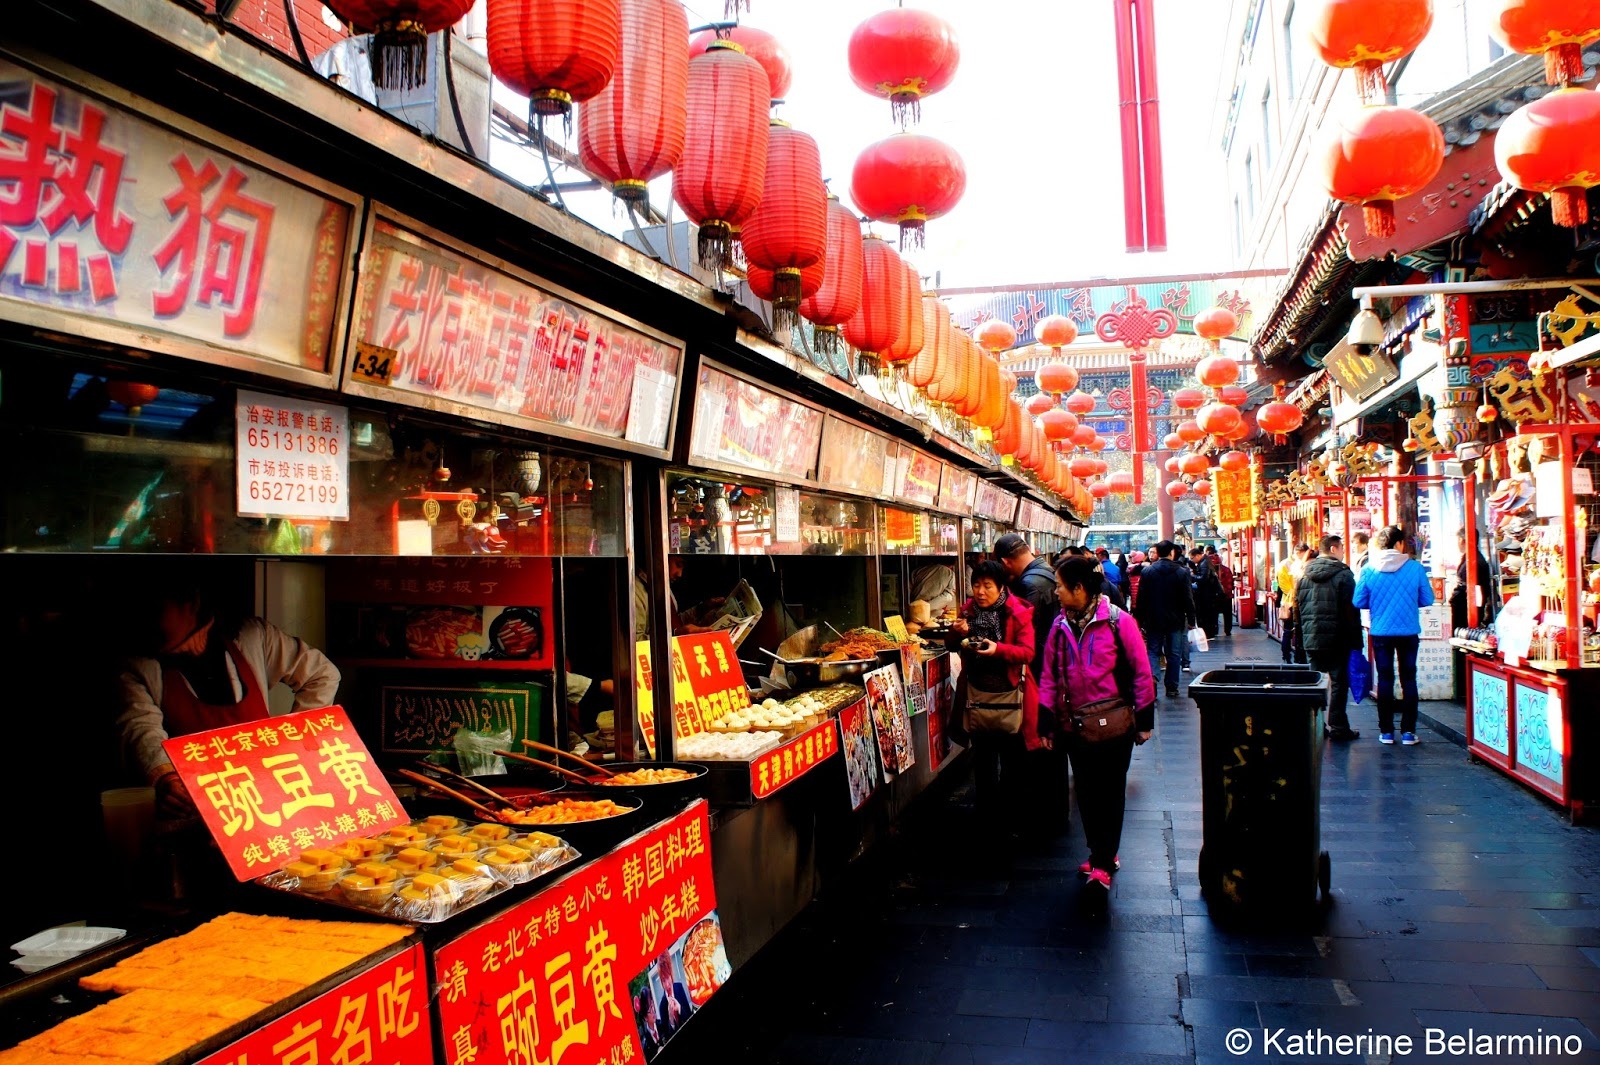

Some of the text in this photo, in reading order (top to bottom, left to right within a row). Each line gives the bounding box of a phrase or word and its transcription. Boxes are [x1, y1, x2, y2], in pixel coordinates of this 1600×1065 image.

[0, 80, 276, 338] 热狗
[967, 283, 1252, 335] 老北京吃街
[248, 427, 338, 455] 65131386
[250, 480, 338, 503] 65272199
[1367, 484, 1382, 507] 热饮
[693, 640, 729, 678] 天津
[183, 713, 345, 762] 老北京特色小吃
[758, 725, 833, 795] 天津狗不理包子
[197, 737, 383, 837] 豌豆黄
[621, 817, 706, 904] 韩国料理
[481, 875, 612, 973] 老北京特色小吃
[640, 876, 700, 956] 炒年糕
[226, 966, 420, 1065] 京名吃
[442, 959, 479, 1065] 清真
[497, 920, 623, 1065] 豌豆黄
